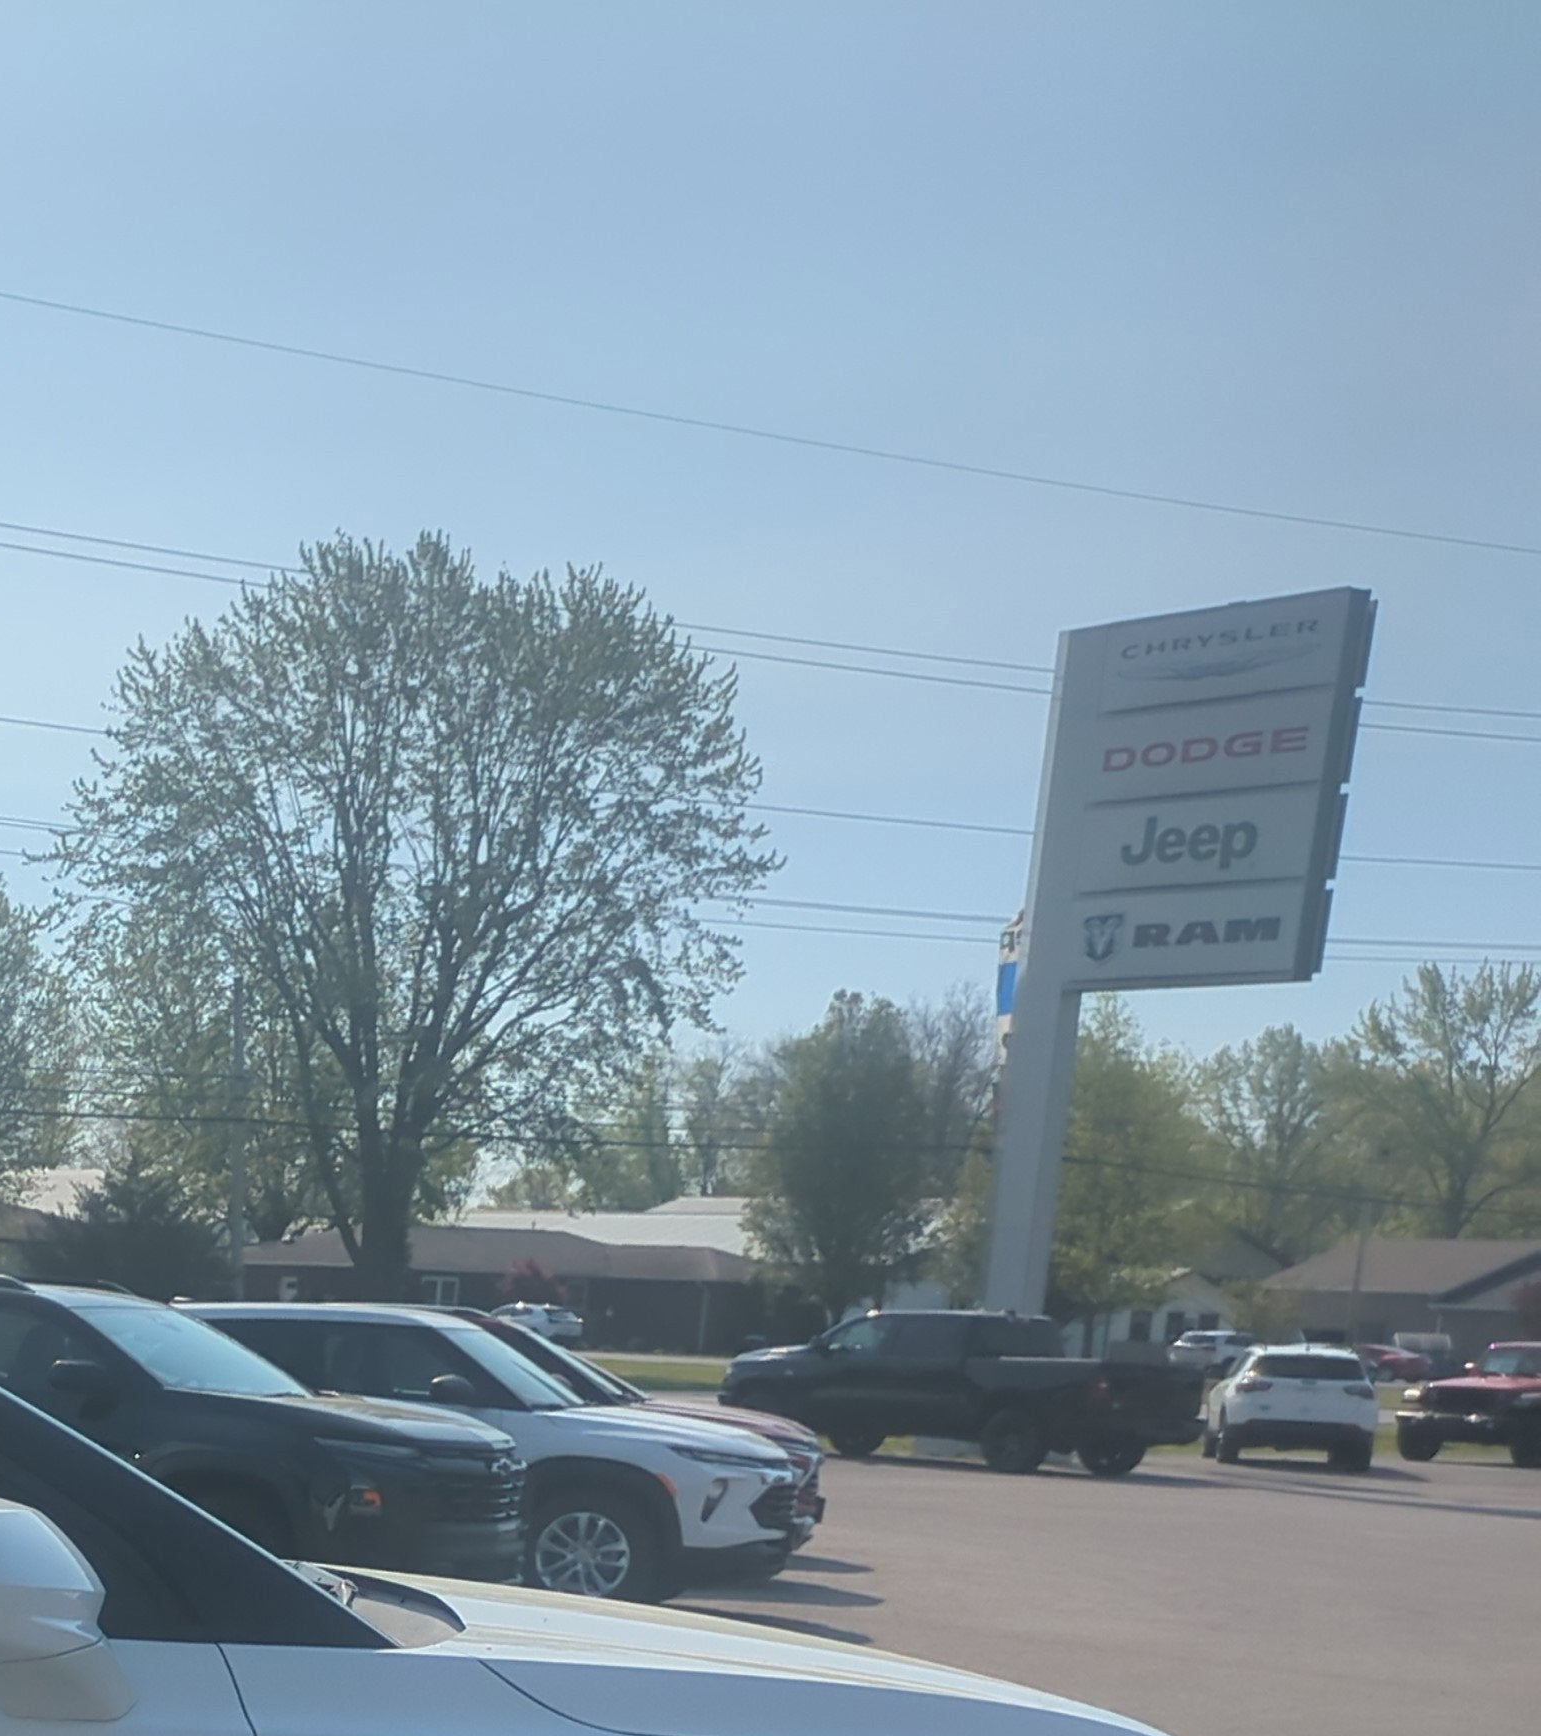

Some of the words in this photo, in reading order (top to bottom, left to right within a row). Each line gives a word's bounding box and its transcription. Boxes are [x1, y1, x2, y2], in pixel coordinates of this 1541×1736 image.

[1120, 619, 1319, 660] CHRYSLER
[1102, 726, 1309, 772] DODGE
[1120, 816, 1258, 870] Jeep
[1131, 917, 1281, 948] RAM
